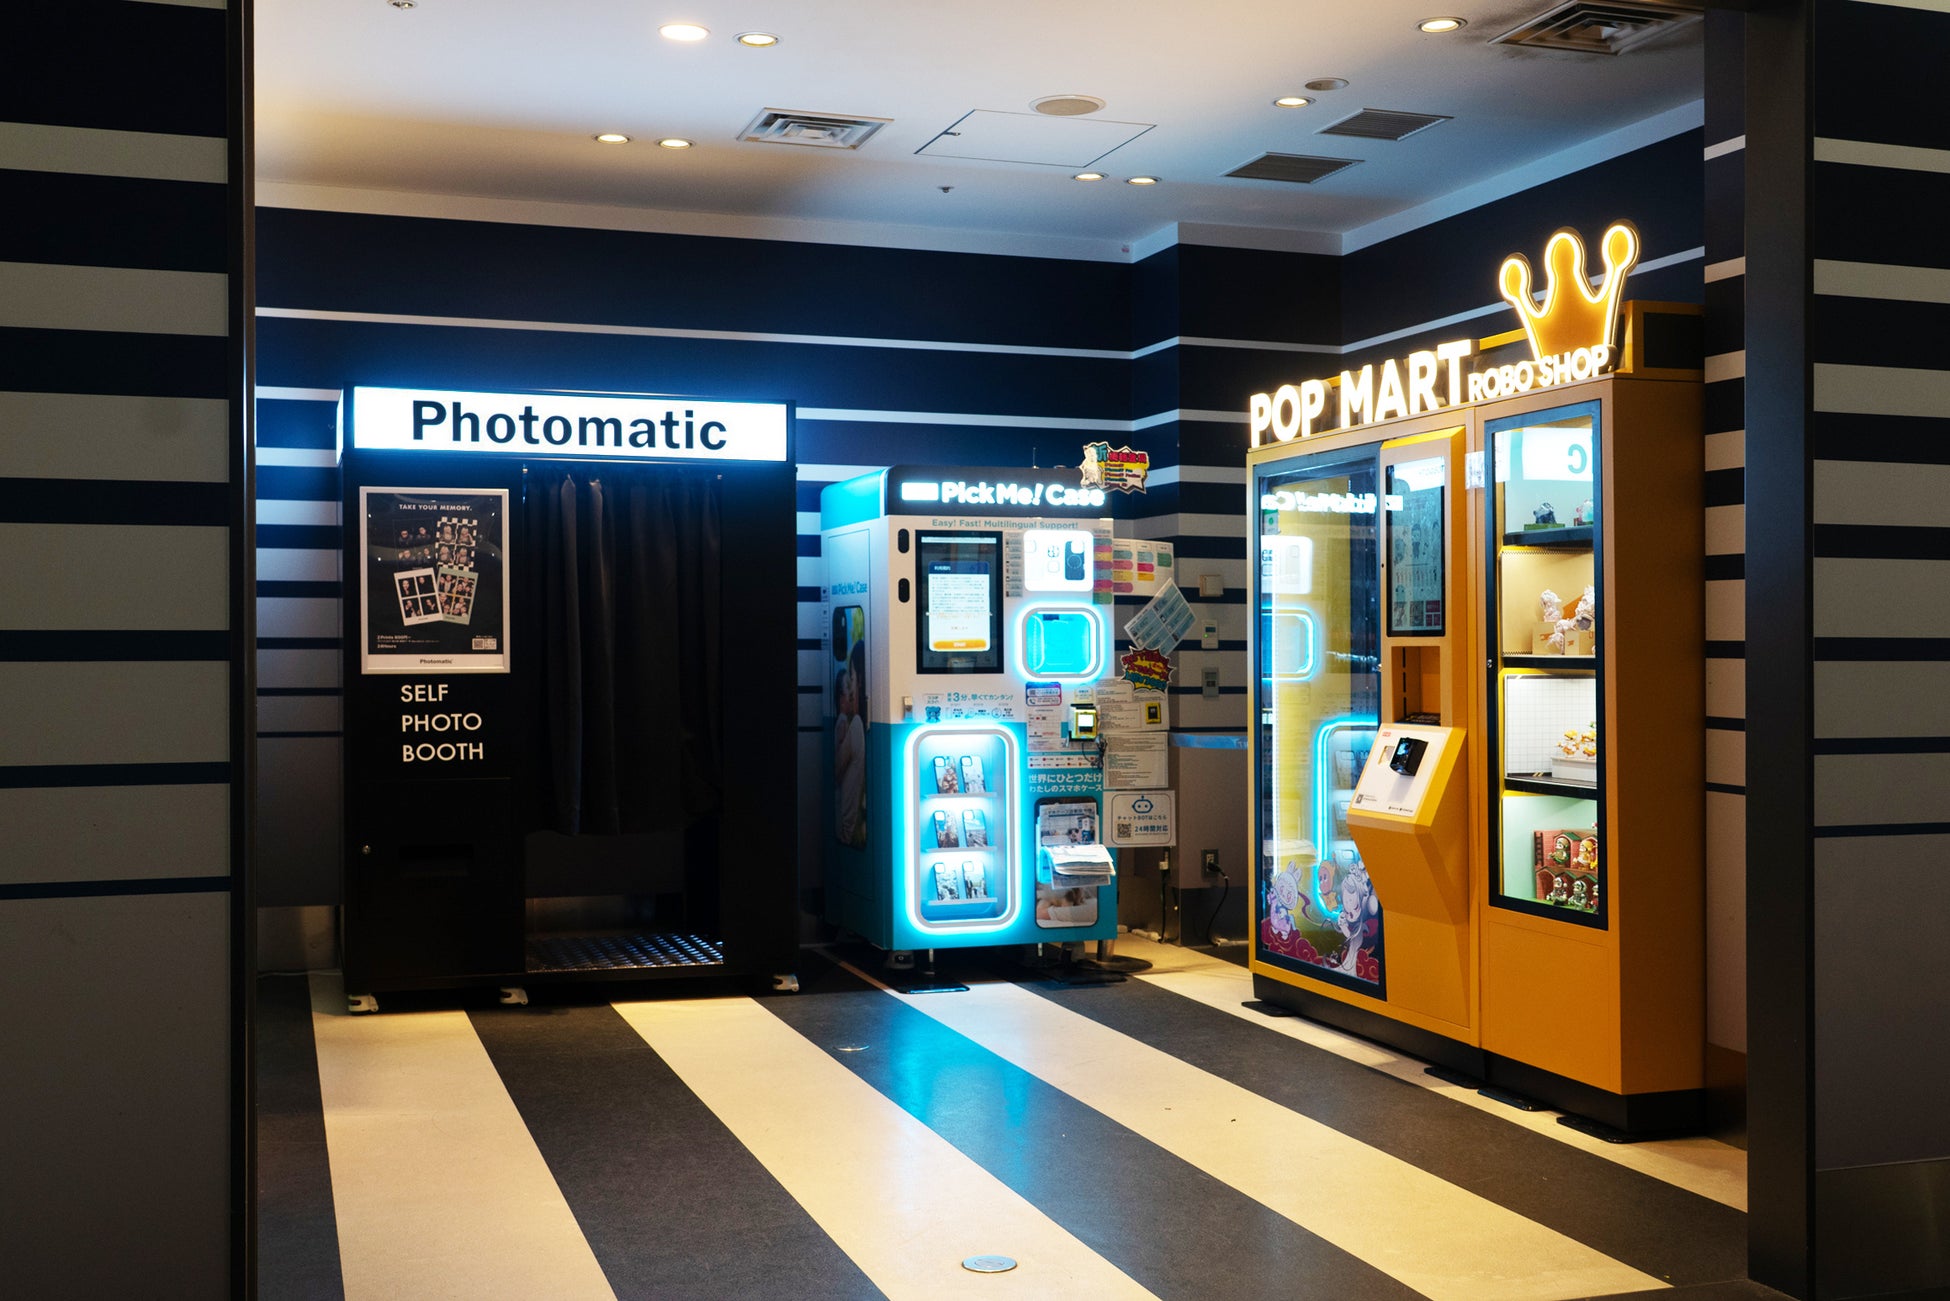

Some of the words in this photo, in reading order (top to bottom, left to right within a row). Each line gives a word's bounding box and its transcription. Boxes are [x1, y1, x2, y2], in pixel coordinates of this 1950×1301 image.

[1250, 379, 1325, 449] POP
[1340, 338, 1472, 430] MART
[1468, 360, 1535, 402] ROBO
[1538, 344, 1610, 388] SHOP
[411, 399, 728, 451] Photomatic
[941, 481, 995, 504] Pick
[996, 483, 1044, 506] Me!
[1045, 484, 1106, 506] Case
[932, 519, 956, 528] Easy!
[959, 519, 981, 527] Fast!
[984, 520, 1037, 529] Multilingual
[1040, 520, 1078, 529] Support!
[400, 684, 449, 704] SELF
[401, 712, 483, 733] PHOTO
[402, 742, 484, 763] BOOTH
[1028, 773, 1103, 784] 世界にひとつだけ
[1029, 784, 1103, 793] わたしのスマホケース
